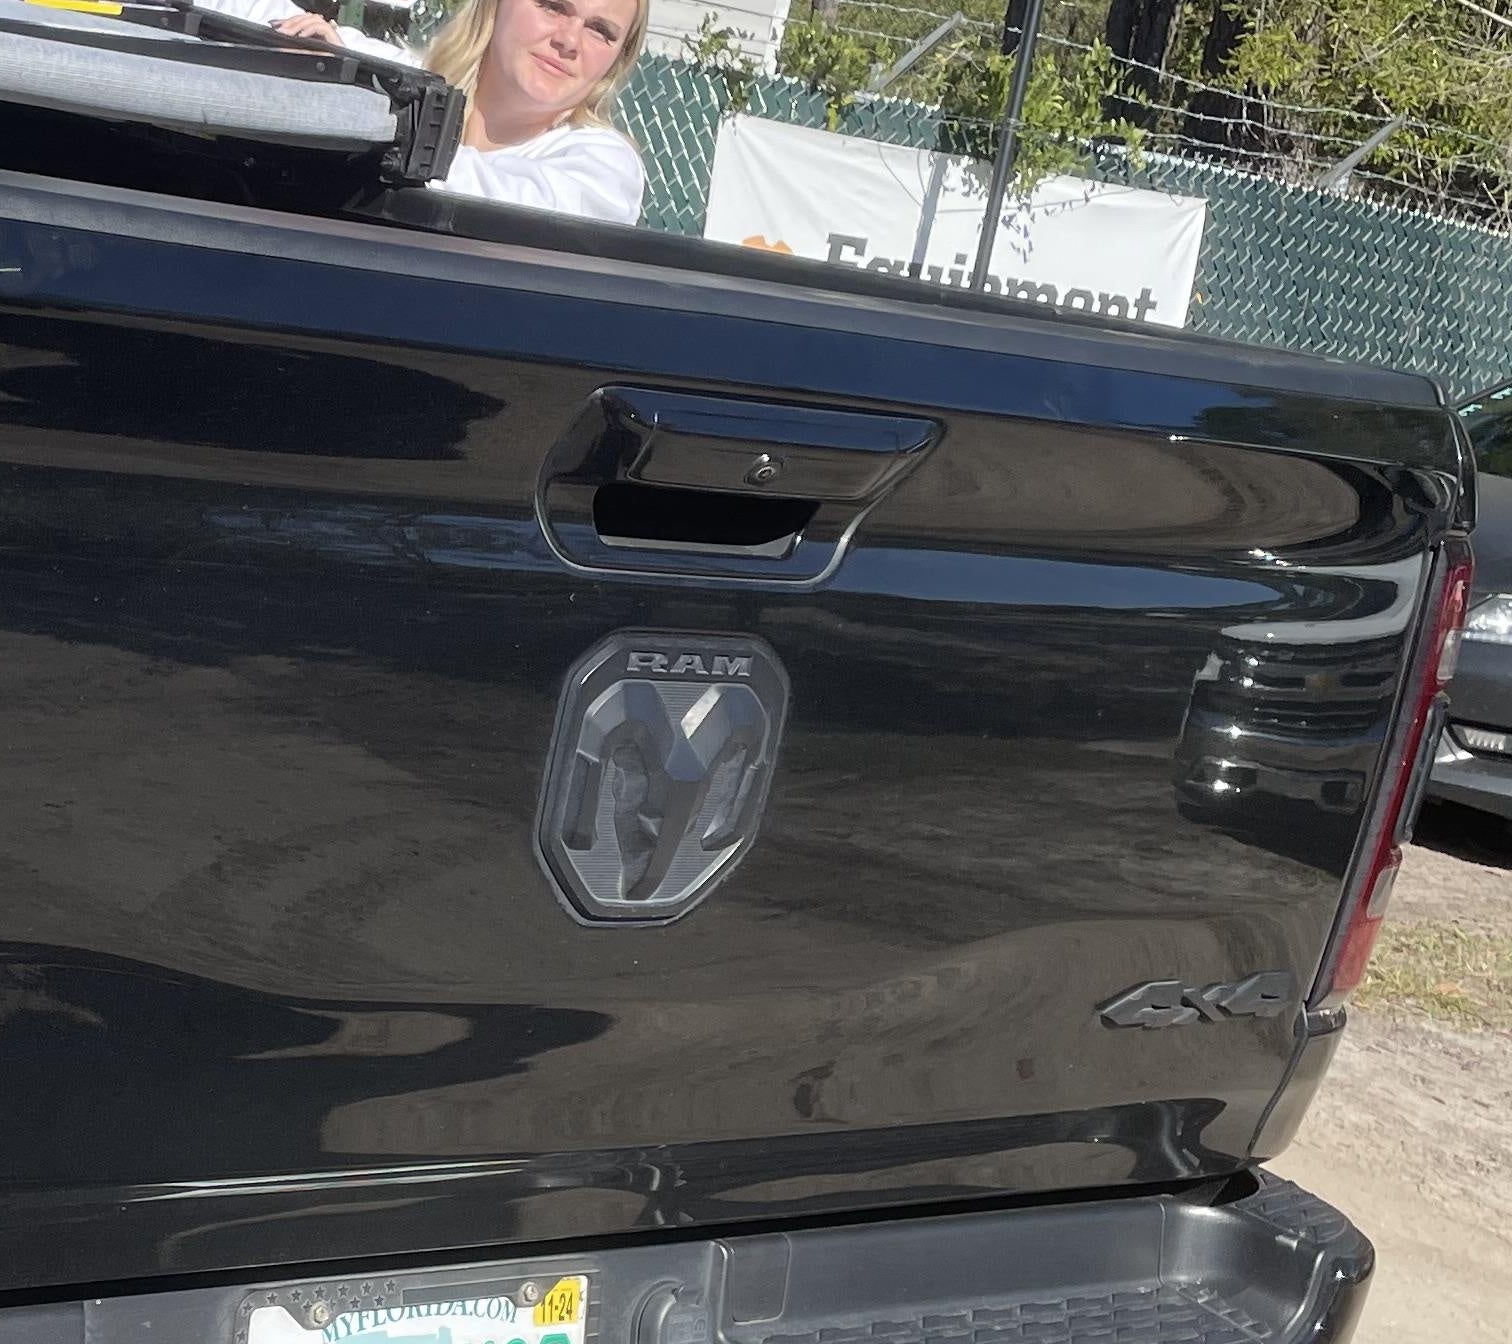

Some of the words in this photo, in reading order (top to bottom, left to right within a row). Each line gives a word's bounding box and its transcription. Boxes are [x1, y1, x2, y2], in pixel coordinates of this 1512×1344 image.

[827, 231, 1158, 322] Eiment
[626, 652, 753, 677] RAM
[541, 1291, 573, 1323] 11-24
